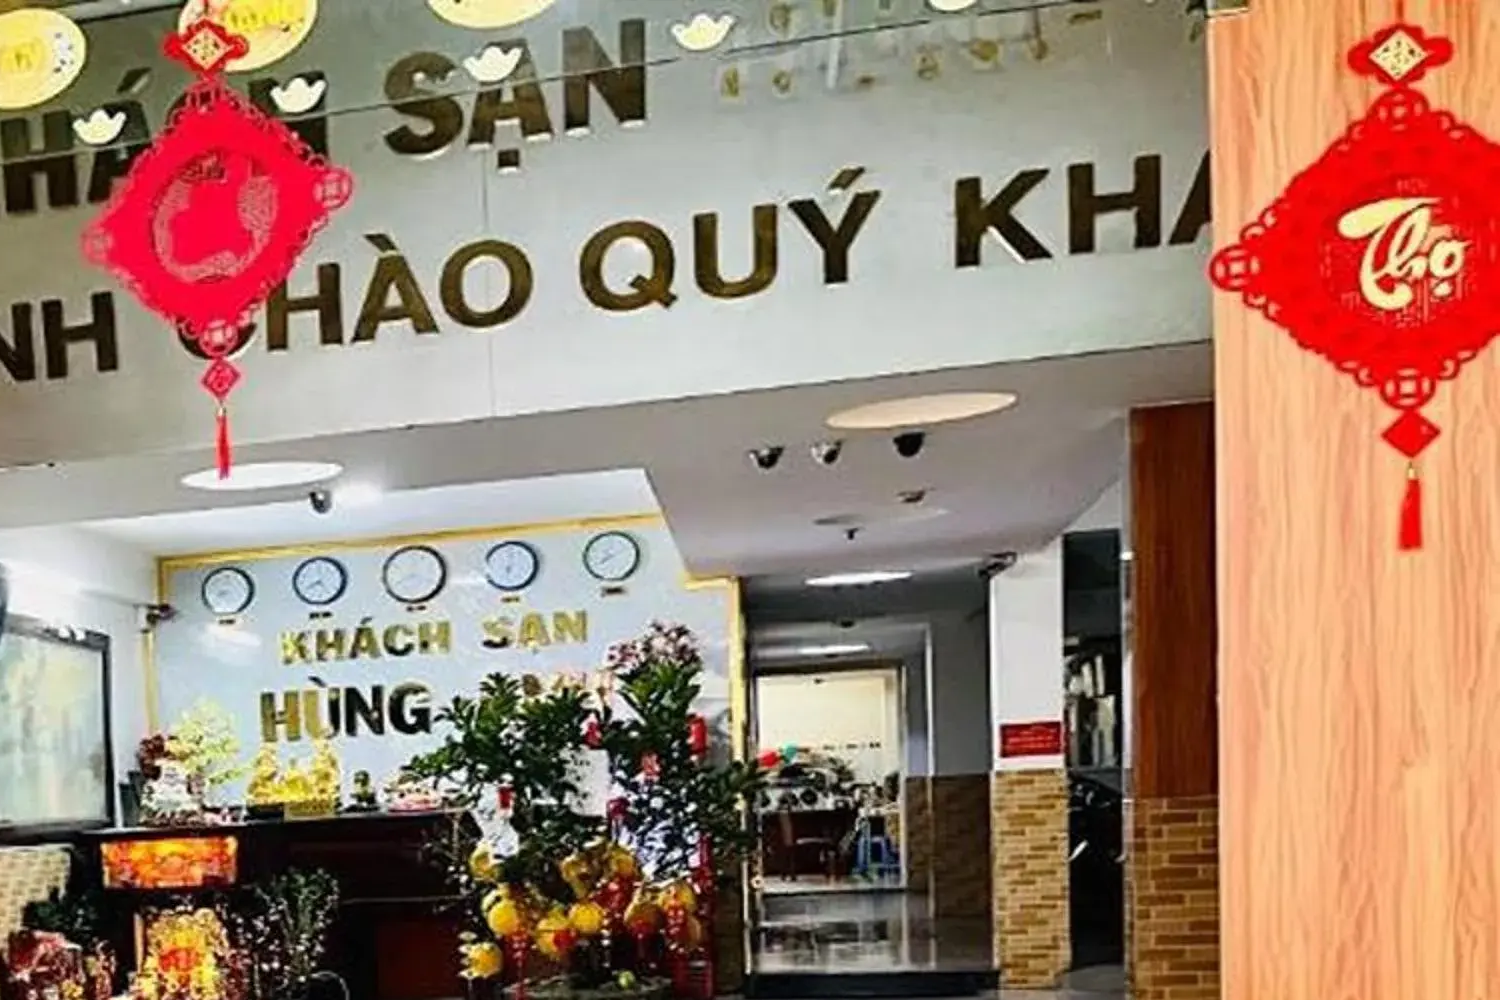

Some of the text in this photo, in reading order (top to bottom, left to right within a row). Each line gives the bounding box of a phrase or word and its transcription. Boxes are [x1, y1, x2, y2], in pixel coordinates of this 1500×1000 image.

[384, 18, 647, 168] SẠN
[178, 232, 534, 360] HÀO
[579, 166, 881, 312] QUÝ
[1337, 197, 1473, 311] Thọ
[280, 609, 588, 665] KHÁCH SẠN
[260, 675, 432, 742] HÙNG
